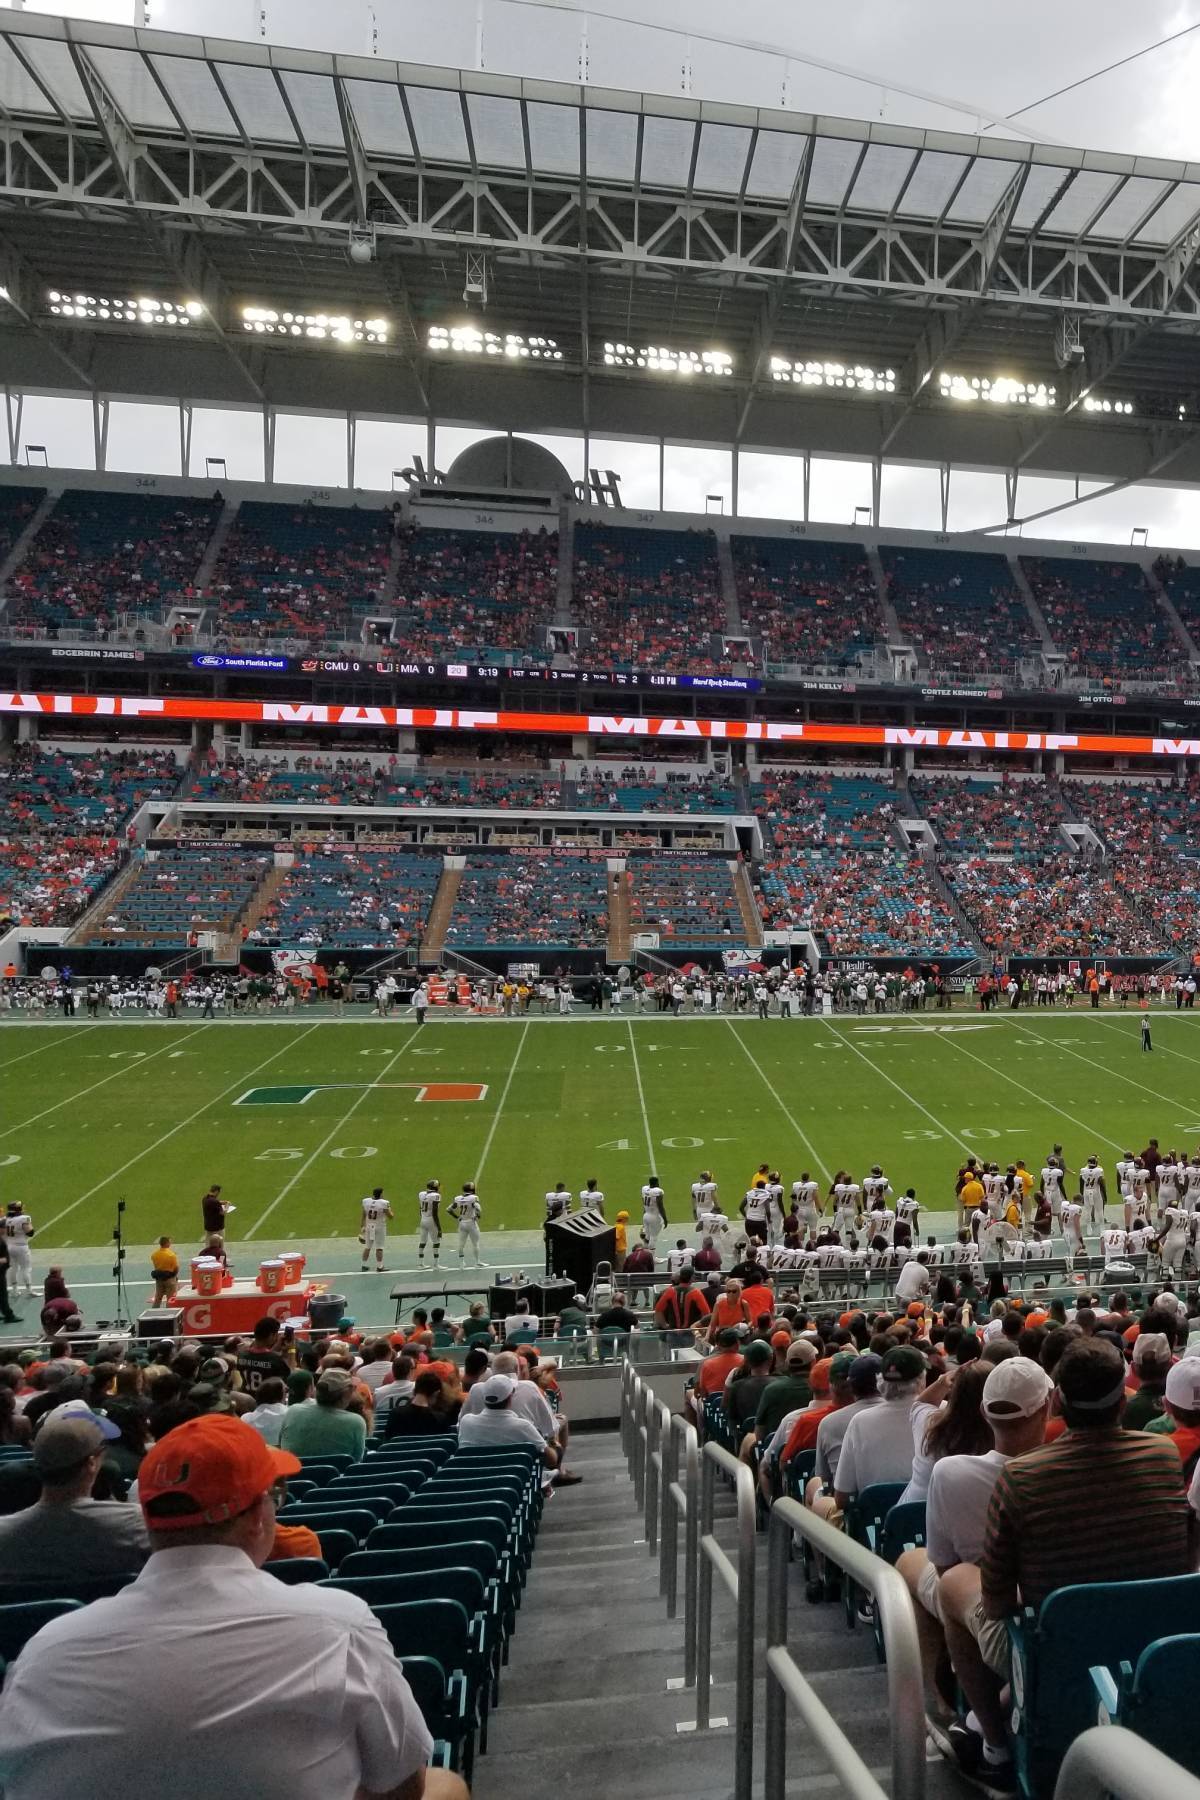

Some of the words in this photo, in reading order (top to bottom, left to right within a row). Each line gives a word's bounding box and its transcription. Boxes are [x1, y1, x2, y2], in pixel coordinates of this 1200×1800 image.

[52, 649, 101, 658] EDGERRIN
[102, 650, 135, 659] JAMES
[225, 658, 244, 666] South
[245, 659, 268, 667] Florida
[324, 661, 349, 671] CMU
[353, 662, 360, 671] 0
[401, 664, 420, 674] MIA
[428, 665, 434, 674] 0
[478, 668, 498, 677] 9:19
[582, 673, 588, 681] 2
[632, 675, 638, 683] 2
[650, 677, 664, 685] 4:10
[667, 677, 677, 686] PM
[921, 688, 951, 696] CORTEZ
[952, 689, 988, 697] KENNEDY
[901, 1127, 1001, 1140] 30
[596, 1137, 705, 1151] 40
[254, 1146, 378, 1161] 50
[186, 1304, 212, 1329] G
